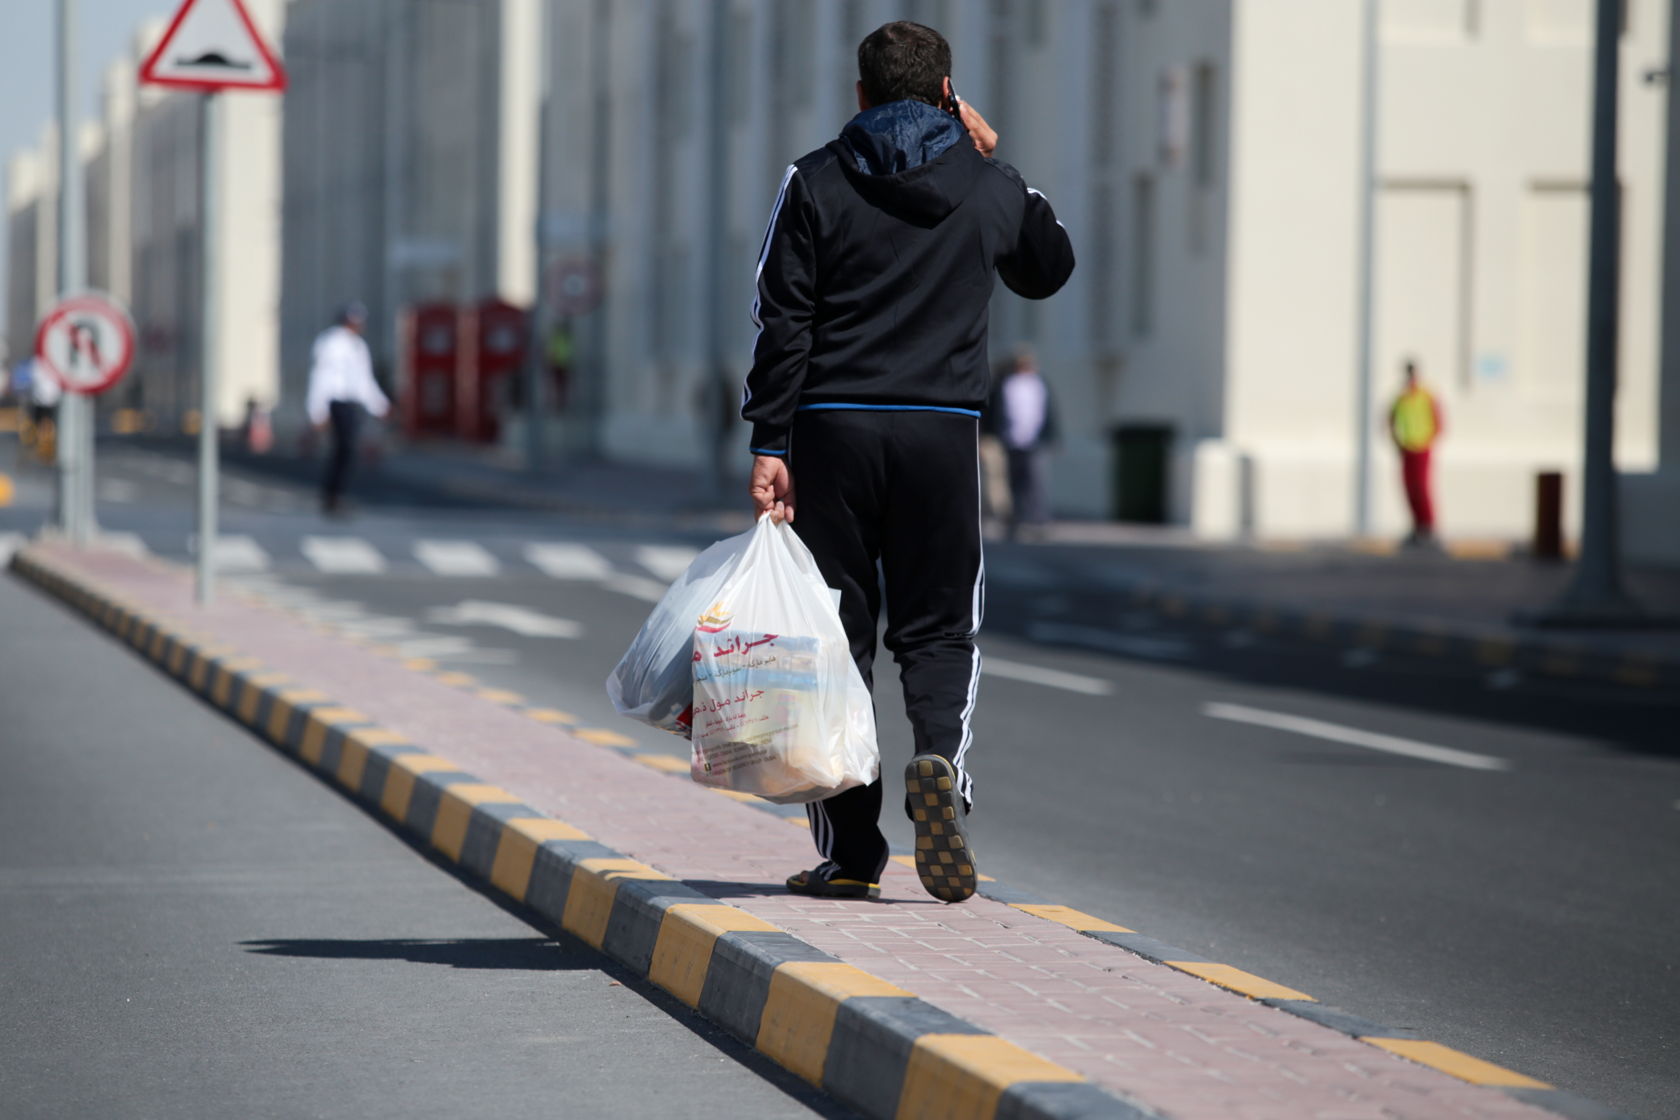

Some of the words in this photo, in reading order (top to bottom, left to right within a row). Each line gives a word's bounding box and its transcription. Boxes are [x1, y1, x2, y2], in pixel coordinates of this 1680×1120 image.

[713, 633, 779, 657] جراند
[734, 688, 766, 703] جراند
[709, 698, 731, 713] مول
